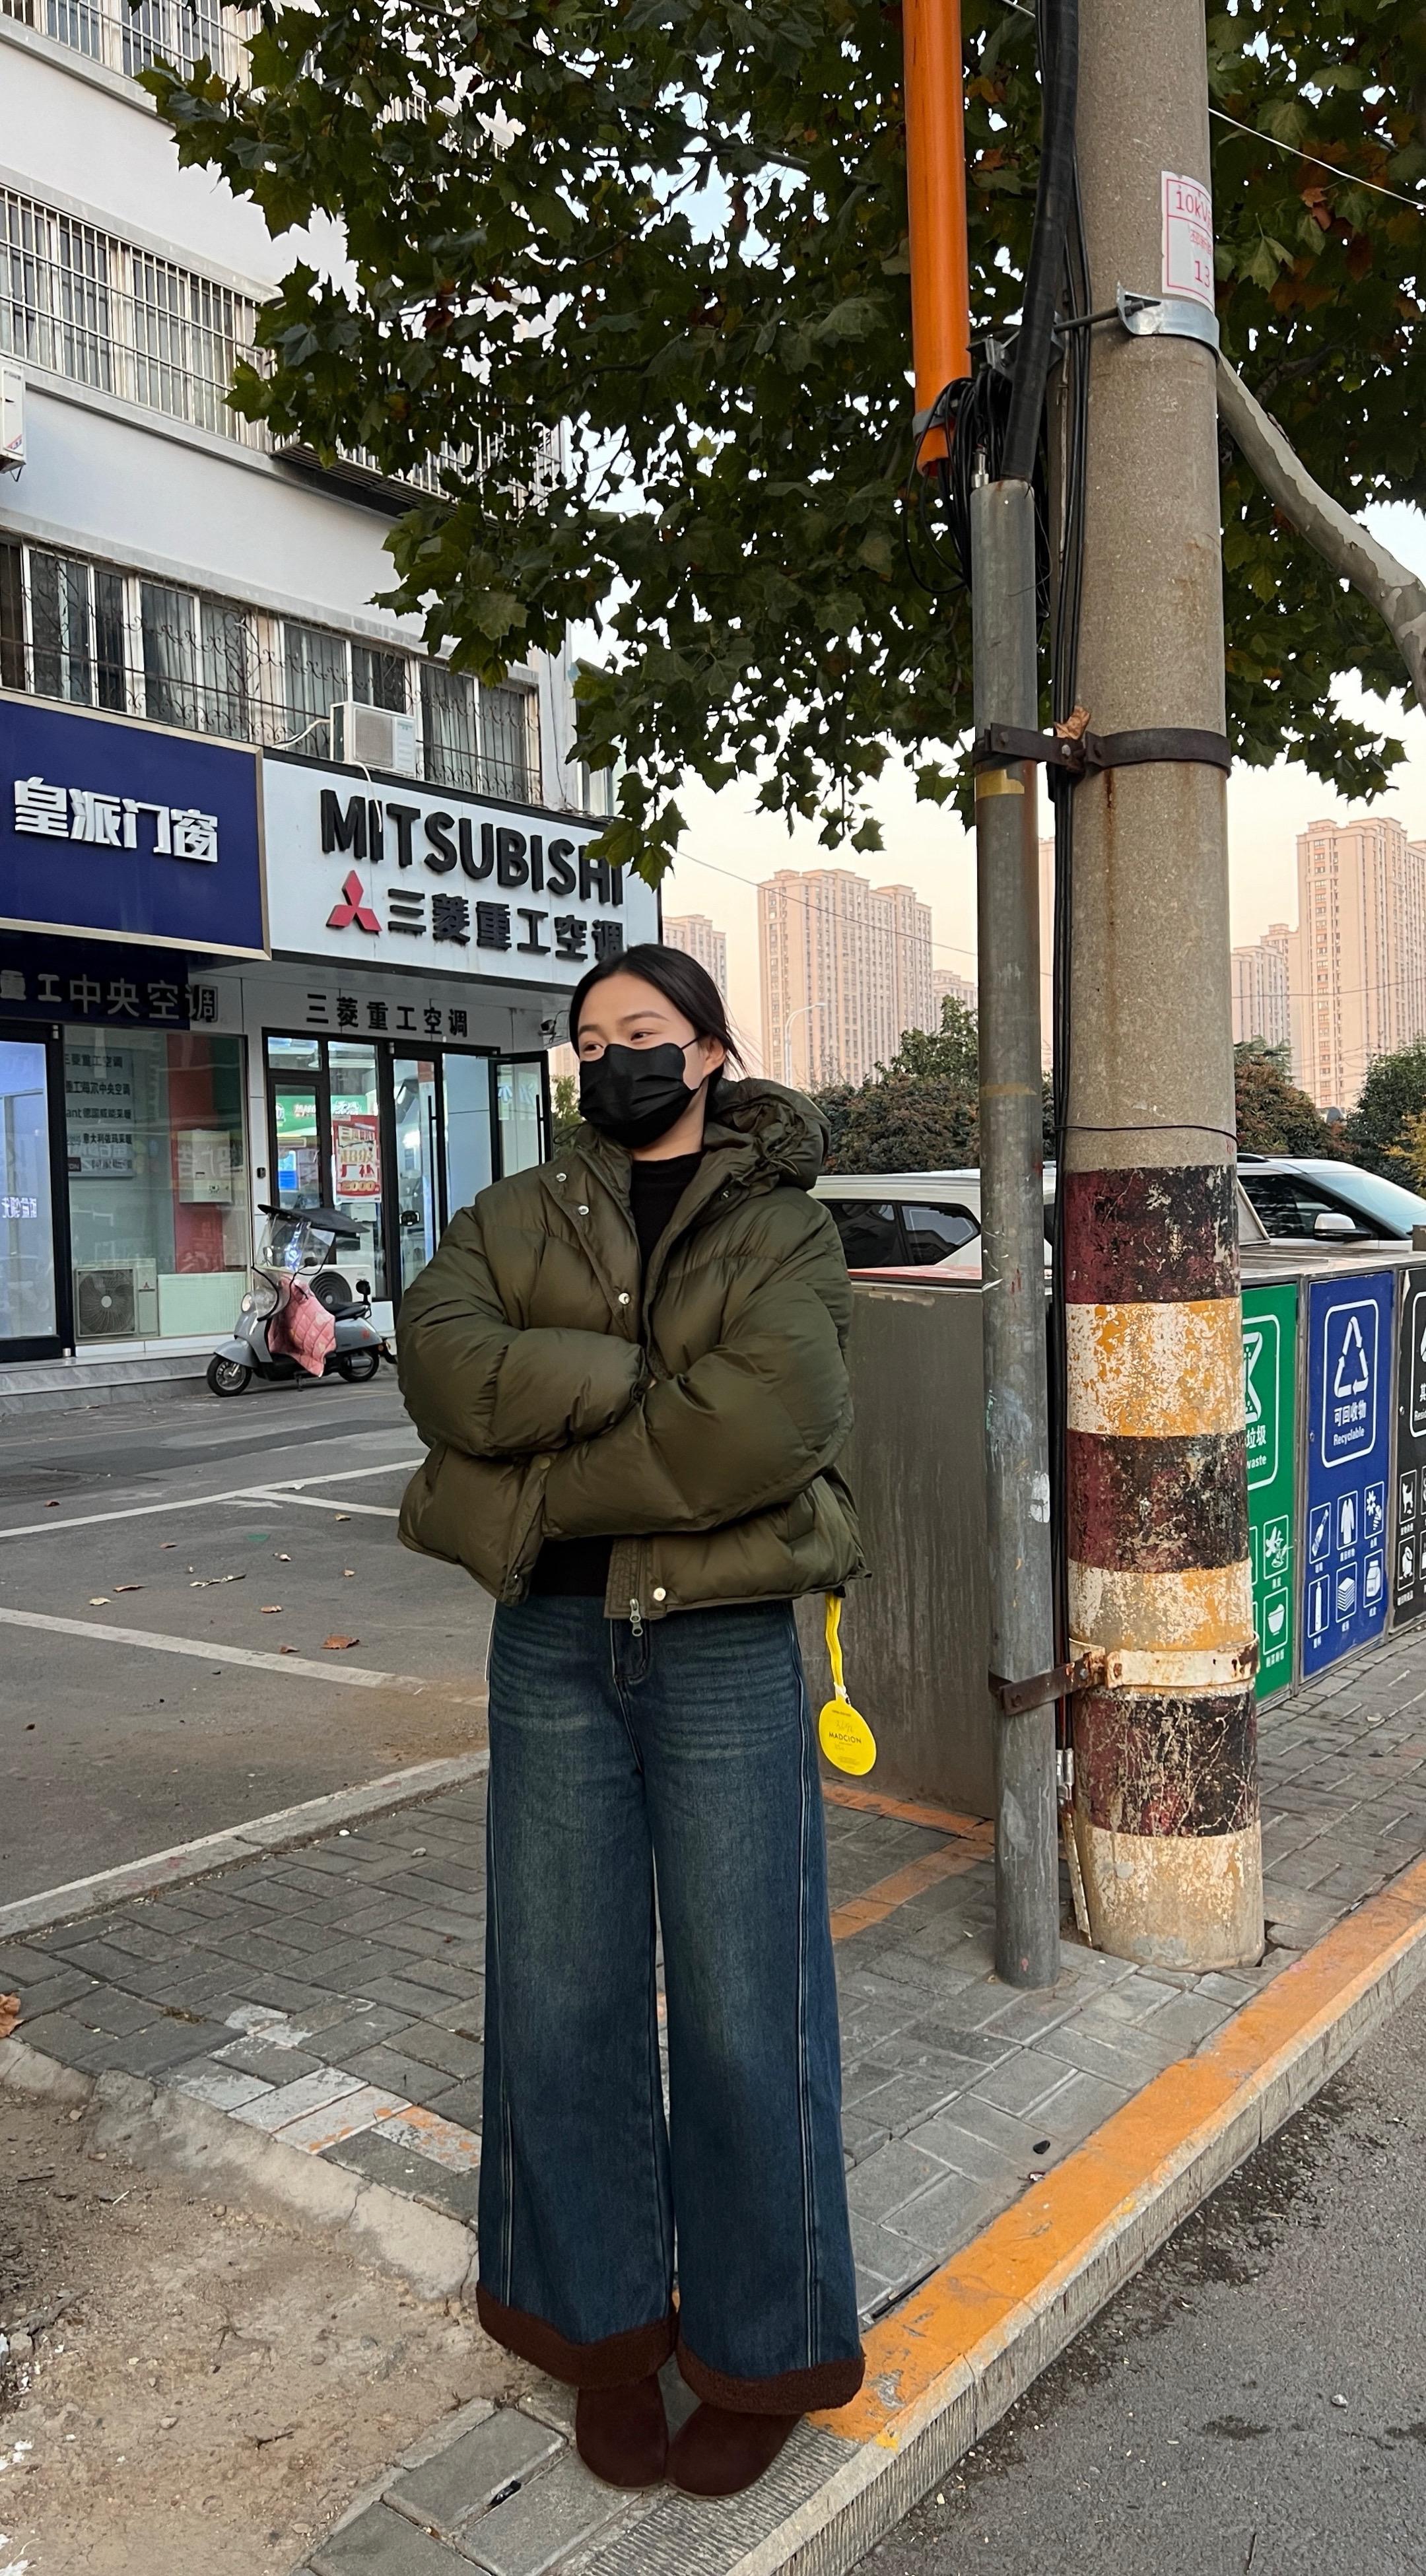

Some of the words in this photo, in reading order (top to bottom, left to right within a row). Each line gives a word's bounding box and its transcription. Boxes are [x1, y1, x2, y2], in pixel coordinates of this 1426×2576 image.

[13, 776, 218, 863] 皇派门窗
[320, 788, 623, 906] MITSUBISHI
[387, 888, 624, 962] 三菱重工空调
[306, 992, 468, 1037] 三菱重工空调
[1334, 1400, 1367, 1427] 可回收物
[1334, 1425, 1365, 1446] Recyclable
[829, 1731, 862, 1744] MADCION
